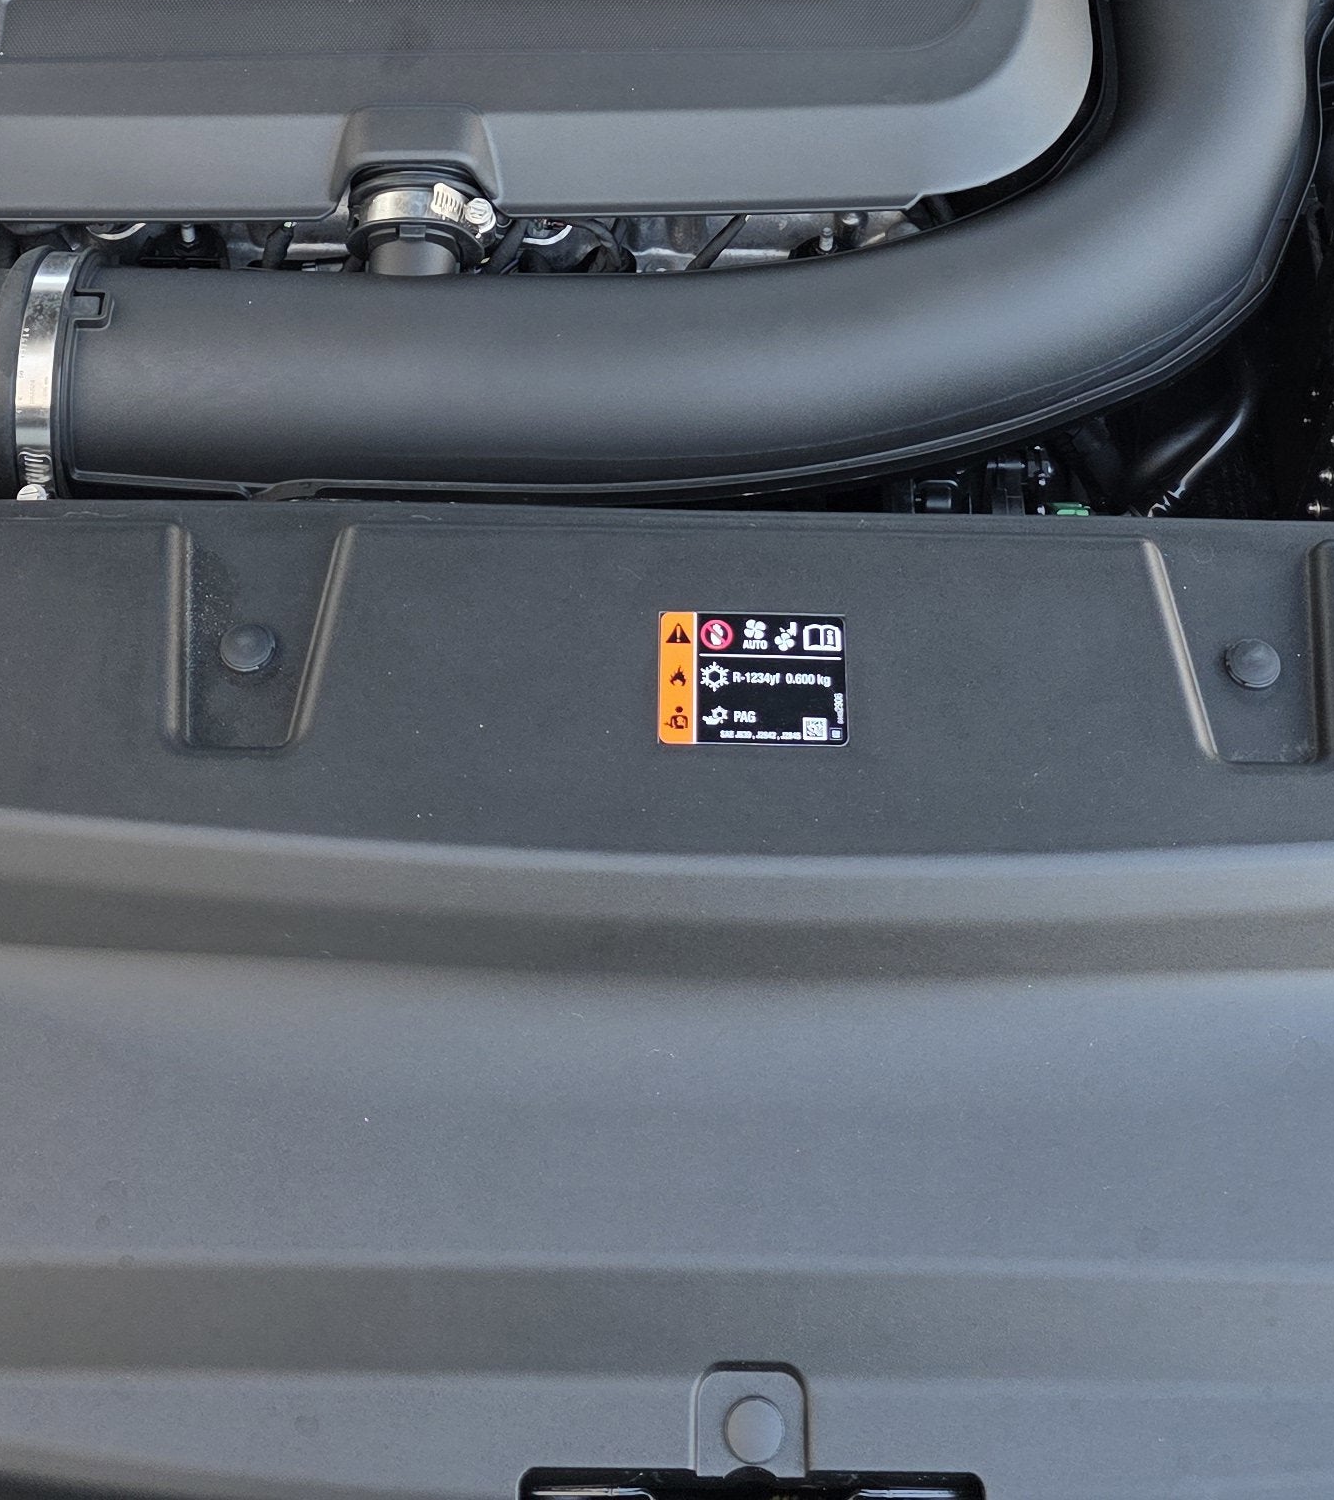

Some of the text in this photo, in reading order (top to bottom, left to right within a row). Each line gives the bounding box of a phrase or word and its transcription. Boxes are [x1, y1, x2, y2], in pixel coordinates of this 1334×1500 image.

[742, 639, 768, 650] AUTO
[732, 671, 832, 687] R-1234yf 0.600 kg
[733, 710, 757, 724] PAG
